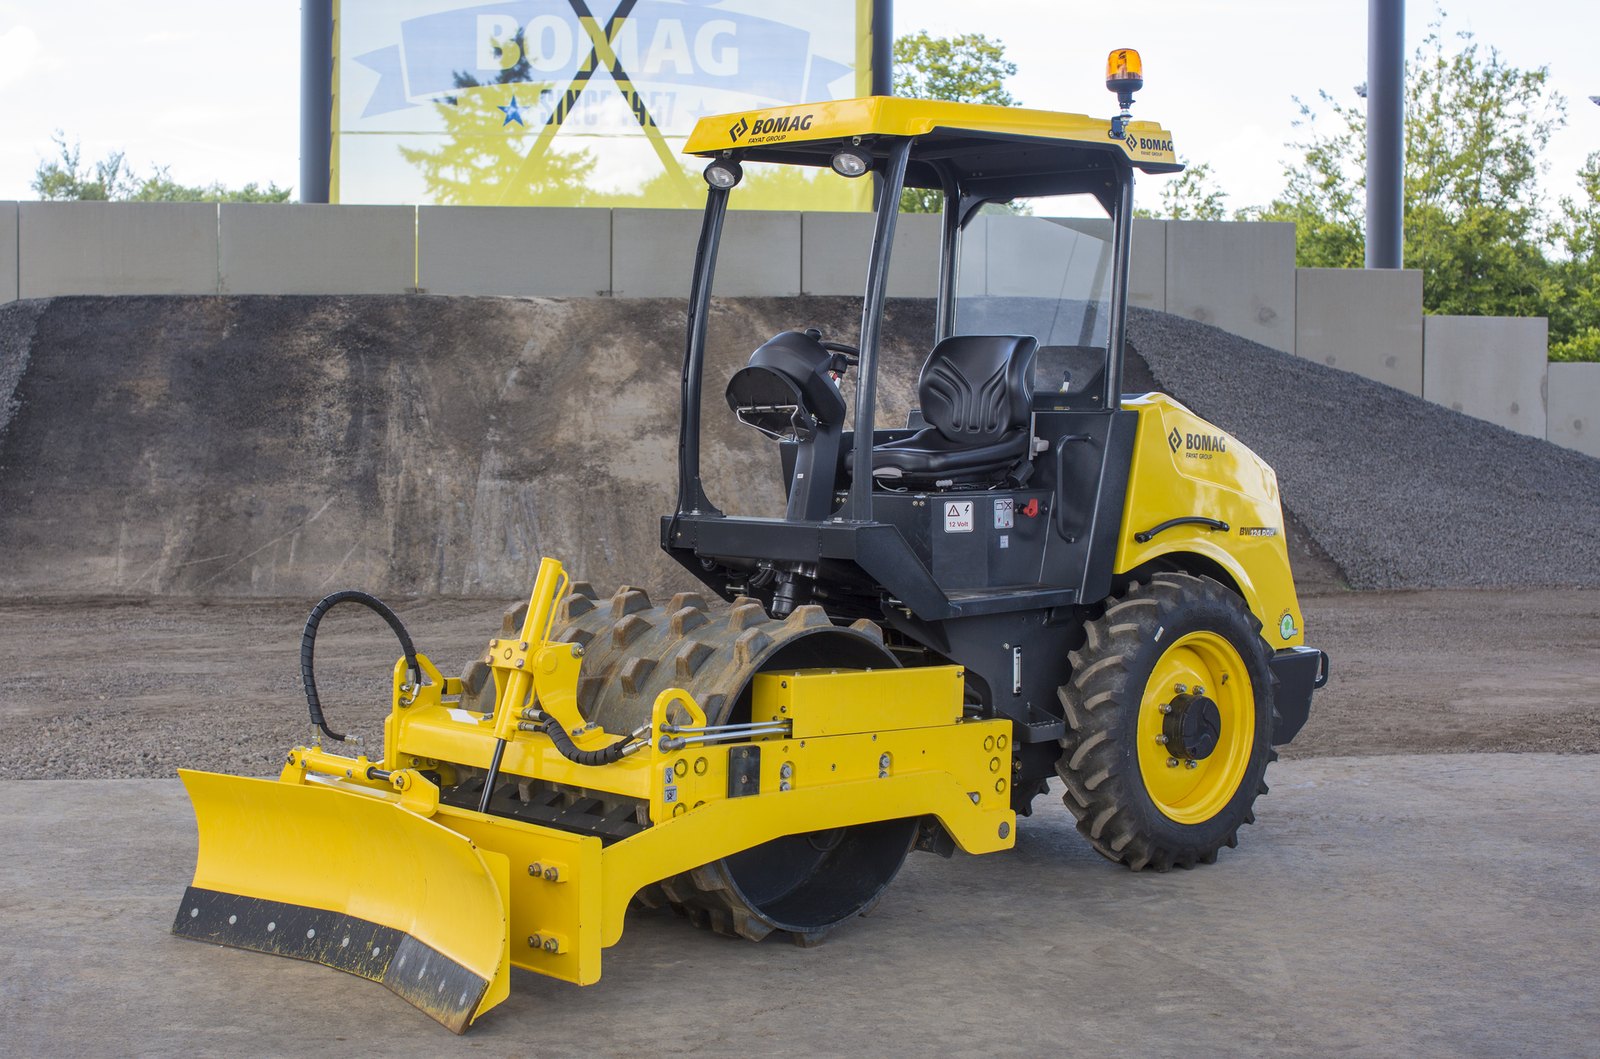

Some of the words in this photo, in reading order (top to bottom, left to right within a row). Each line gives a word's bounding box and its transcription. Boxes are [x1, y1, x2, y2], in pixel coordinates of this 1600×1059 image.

[476, 14, 739, 77] BOMAG
[751, 114, 813, 136] BOMAG
[766, 134, 787, 143] GROUP
[1140, 137, 1173, 152] BOMAG
[1186, 433, 1226, 453] BOMAG
[1186, 452, 1199, 460] FAYAT
